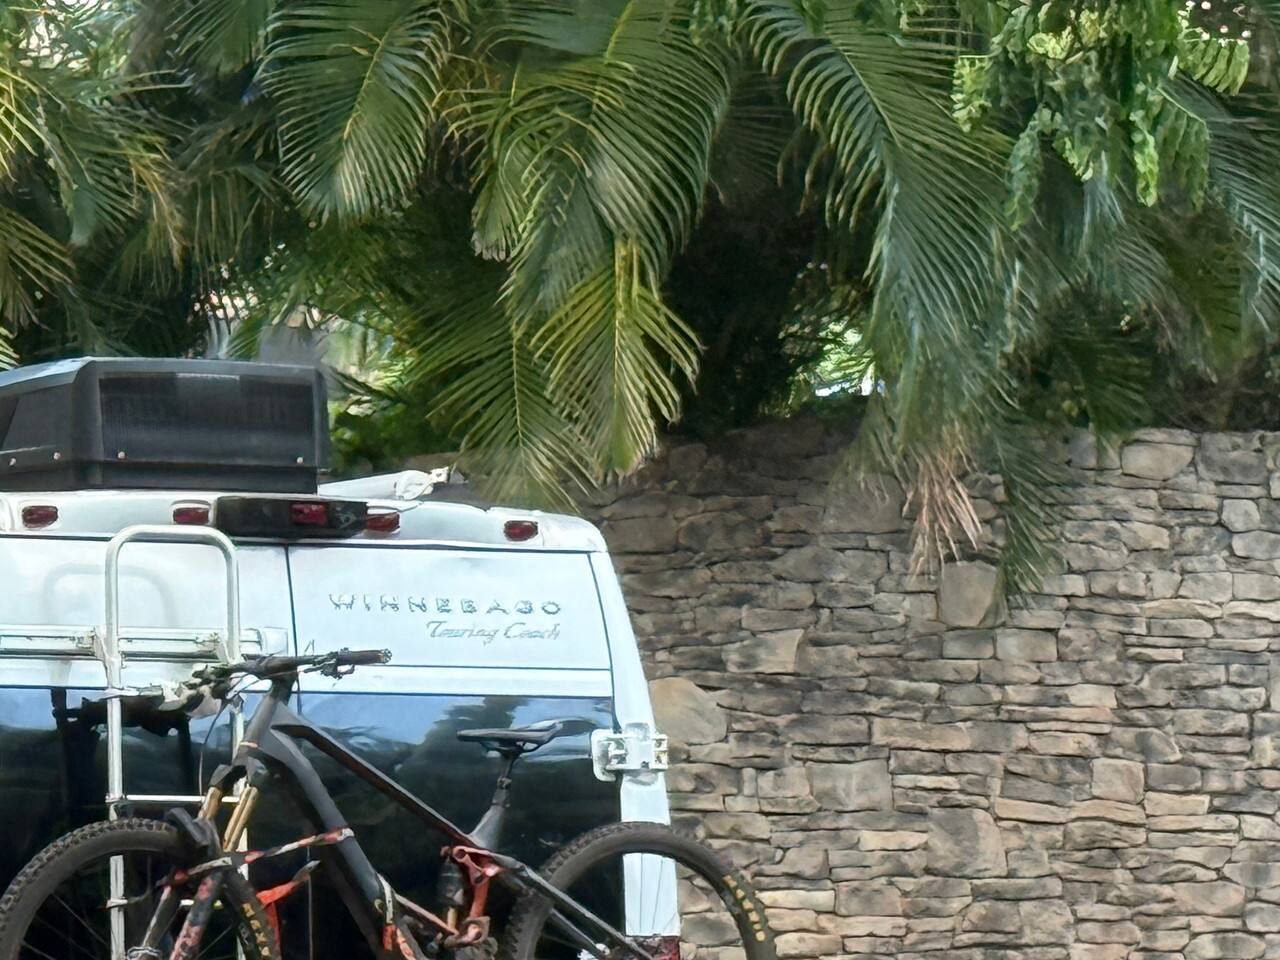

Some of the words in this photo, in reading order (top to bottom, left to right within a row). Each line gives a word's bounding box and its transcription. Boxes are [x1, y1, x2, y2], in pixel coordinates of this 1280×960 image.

[328, 593, 561, 616] WINNEBAGO
[426, 620, 500, 646] Touring
[503, 622, 561, 641] Coach
